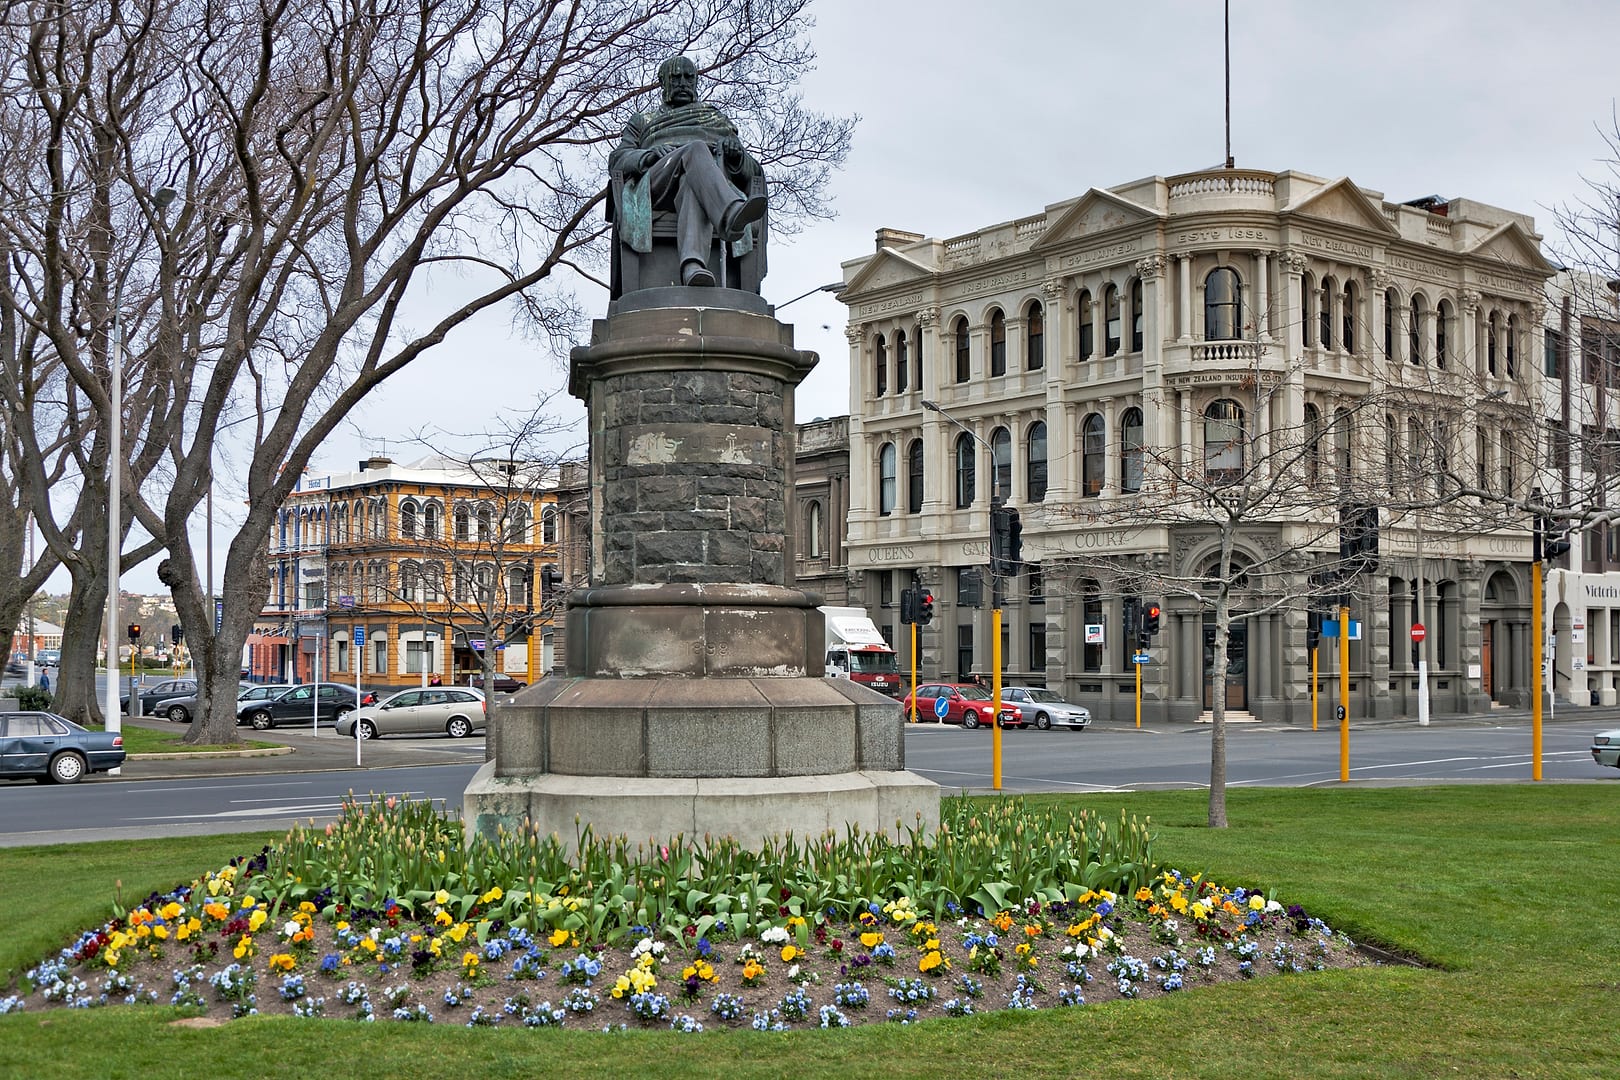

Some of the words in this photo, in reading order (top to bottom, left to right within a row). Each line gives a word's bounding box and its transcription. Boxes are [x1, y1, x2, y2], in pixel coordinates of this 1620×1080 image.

[1302, 234, 1322, 247] NEW
[1325, 239, 1371, 258] ZEALAND
[861, 304, 879, 315] NEW
[880, 294, 923, 311] ZEALAND
[1193, 375, 1222, 383] ZEALAND
[1075, 531, 1126, 549] COURT
[1490, 538, 1526, 552] COURT
[868, 546, 914, 563] QUEENS
[1585, 584, 1618, 599] Victoria
